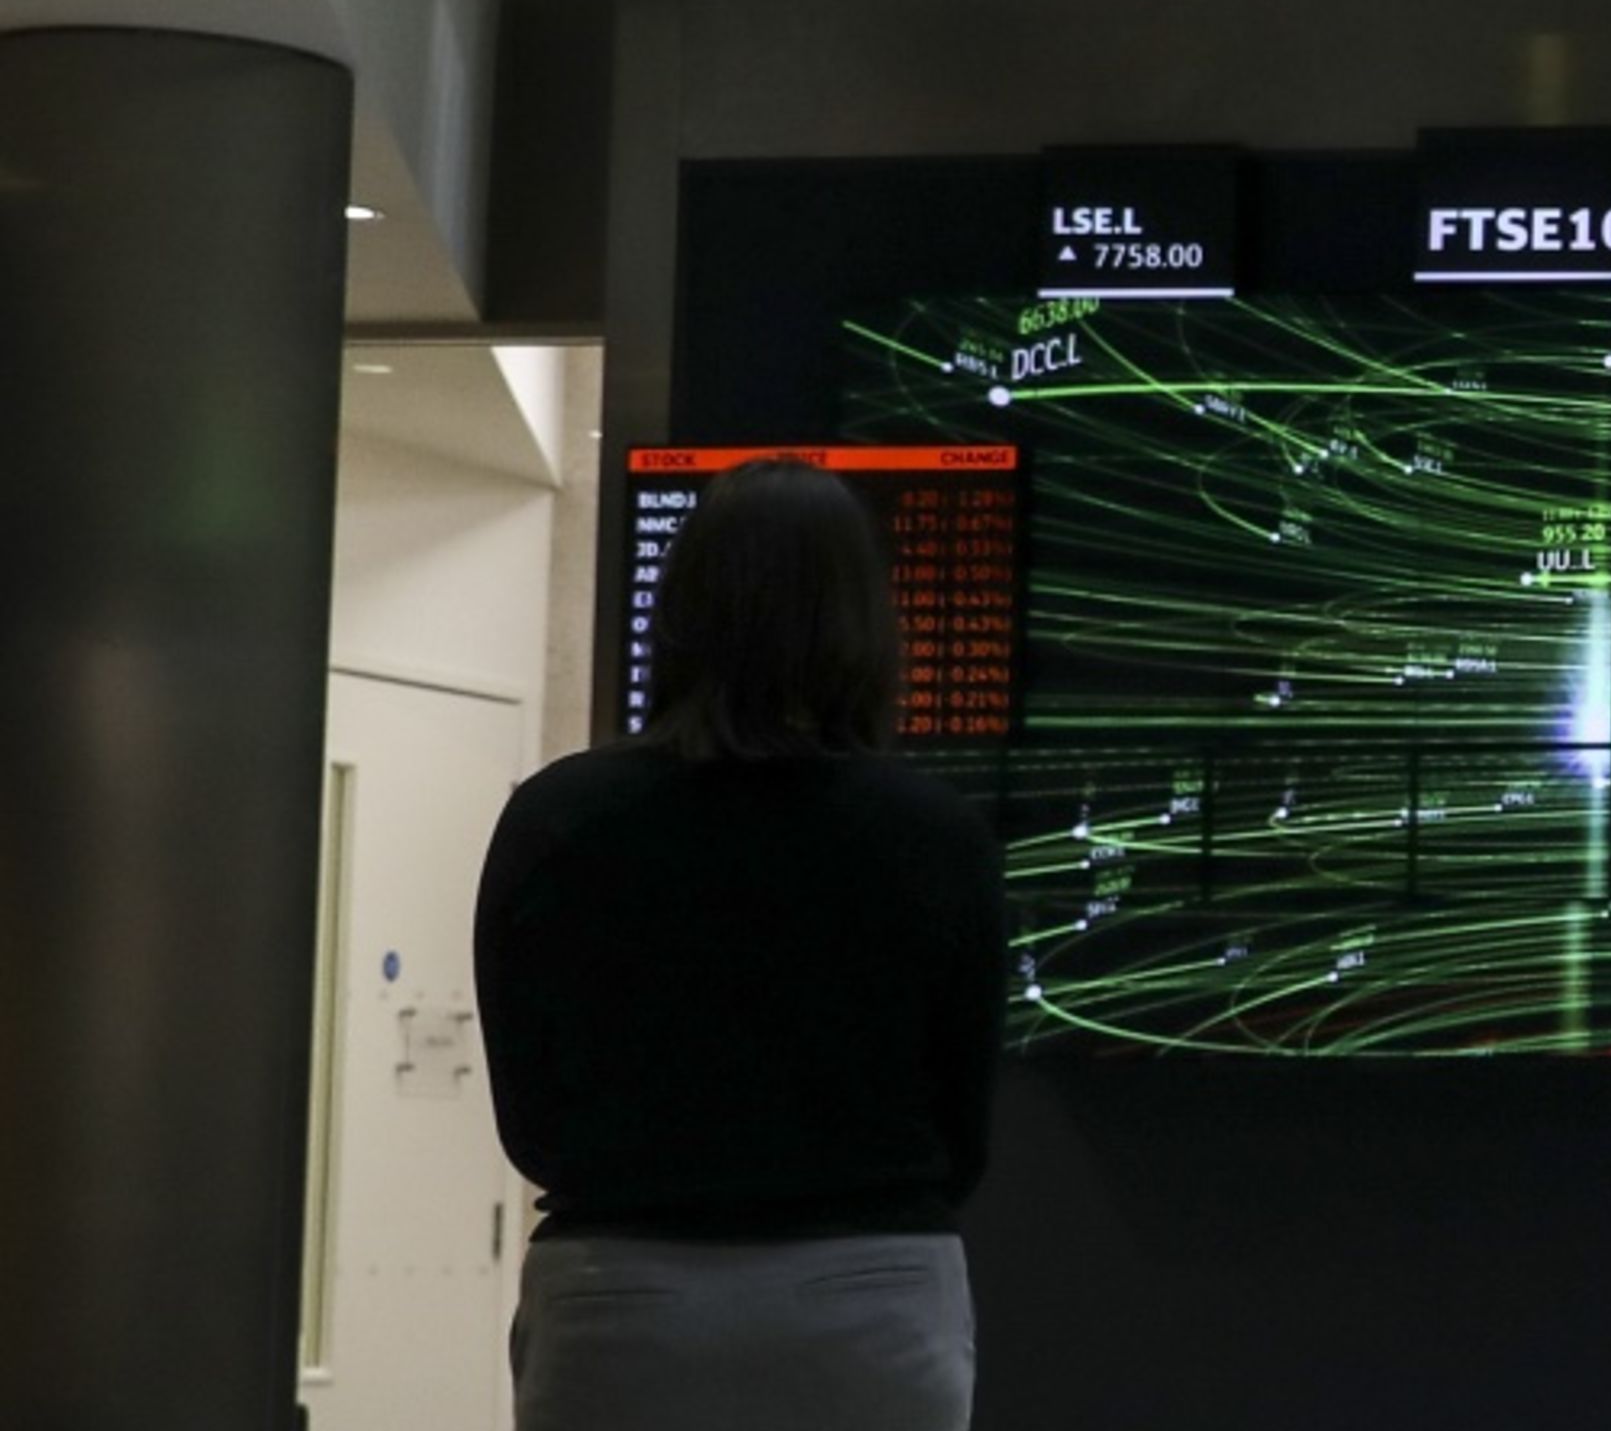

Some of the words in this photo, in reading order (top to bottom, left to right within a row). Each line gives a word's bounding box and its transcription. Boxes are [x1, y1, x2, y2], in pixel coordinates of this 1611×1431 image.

[1054, 208, 1141, 234] LSE.L
[1096, 244, 1202, 268] 7758.00
[1012, 333, 1081, 380] DCC.L
[641, 452, 696, 466] STOCK
[940, 452, 1009, 466] CHANGE
[1542, 523, 1605, 544] 955.20
